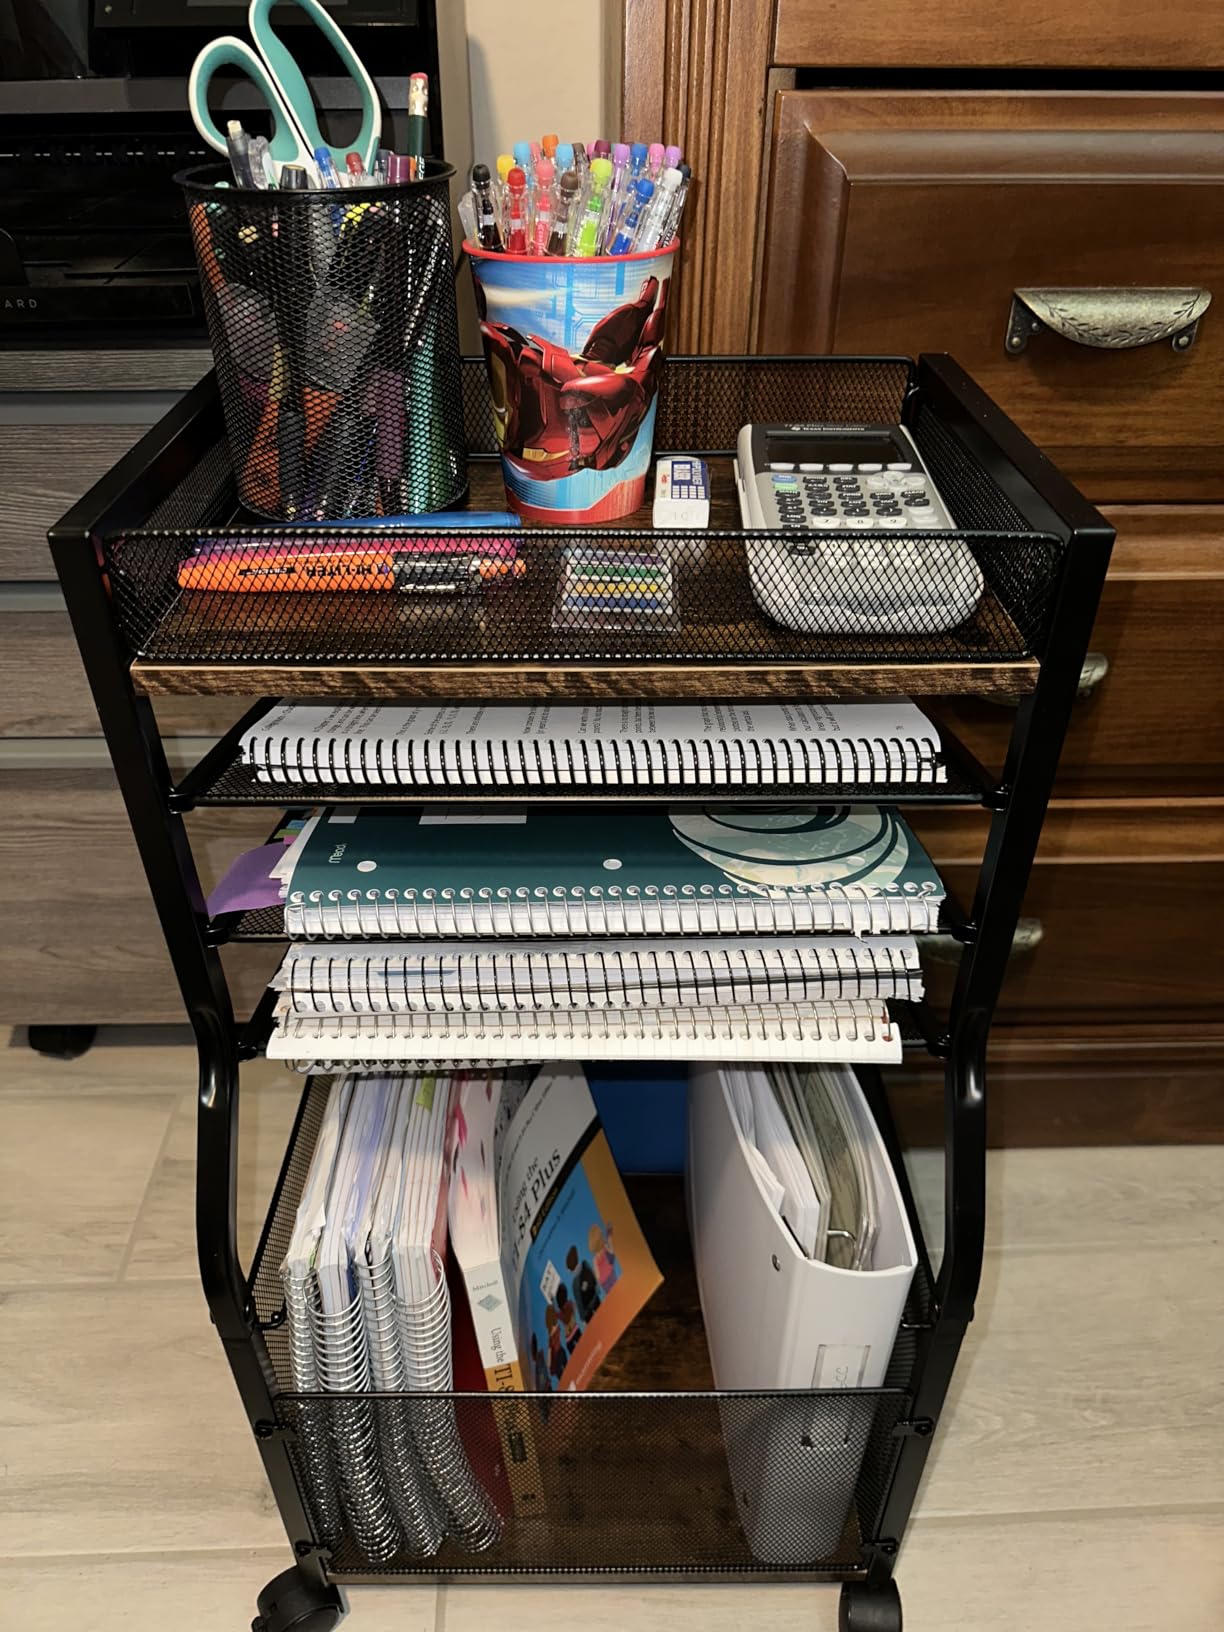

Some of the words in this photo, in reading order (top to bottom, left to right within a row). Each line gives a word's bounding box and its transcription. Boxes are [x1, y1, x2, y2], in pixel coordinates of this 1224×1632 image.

[531, 1147, 561, 1203] Plus
[490, 1327, 504, 1351] Using
[496, 1350, 508, 1363] the
